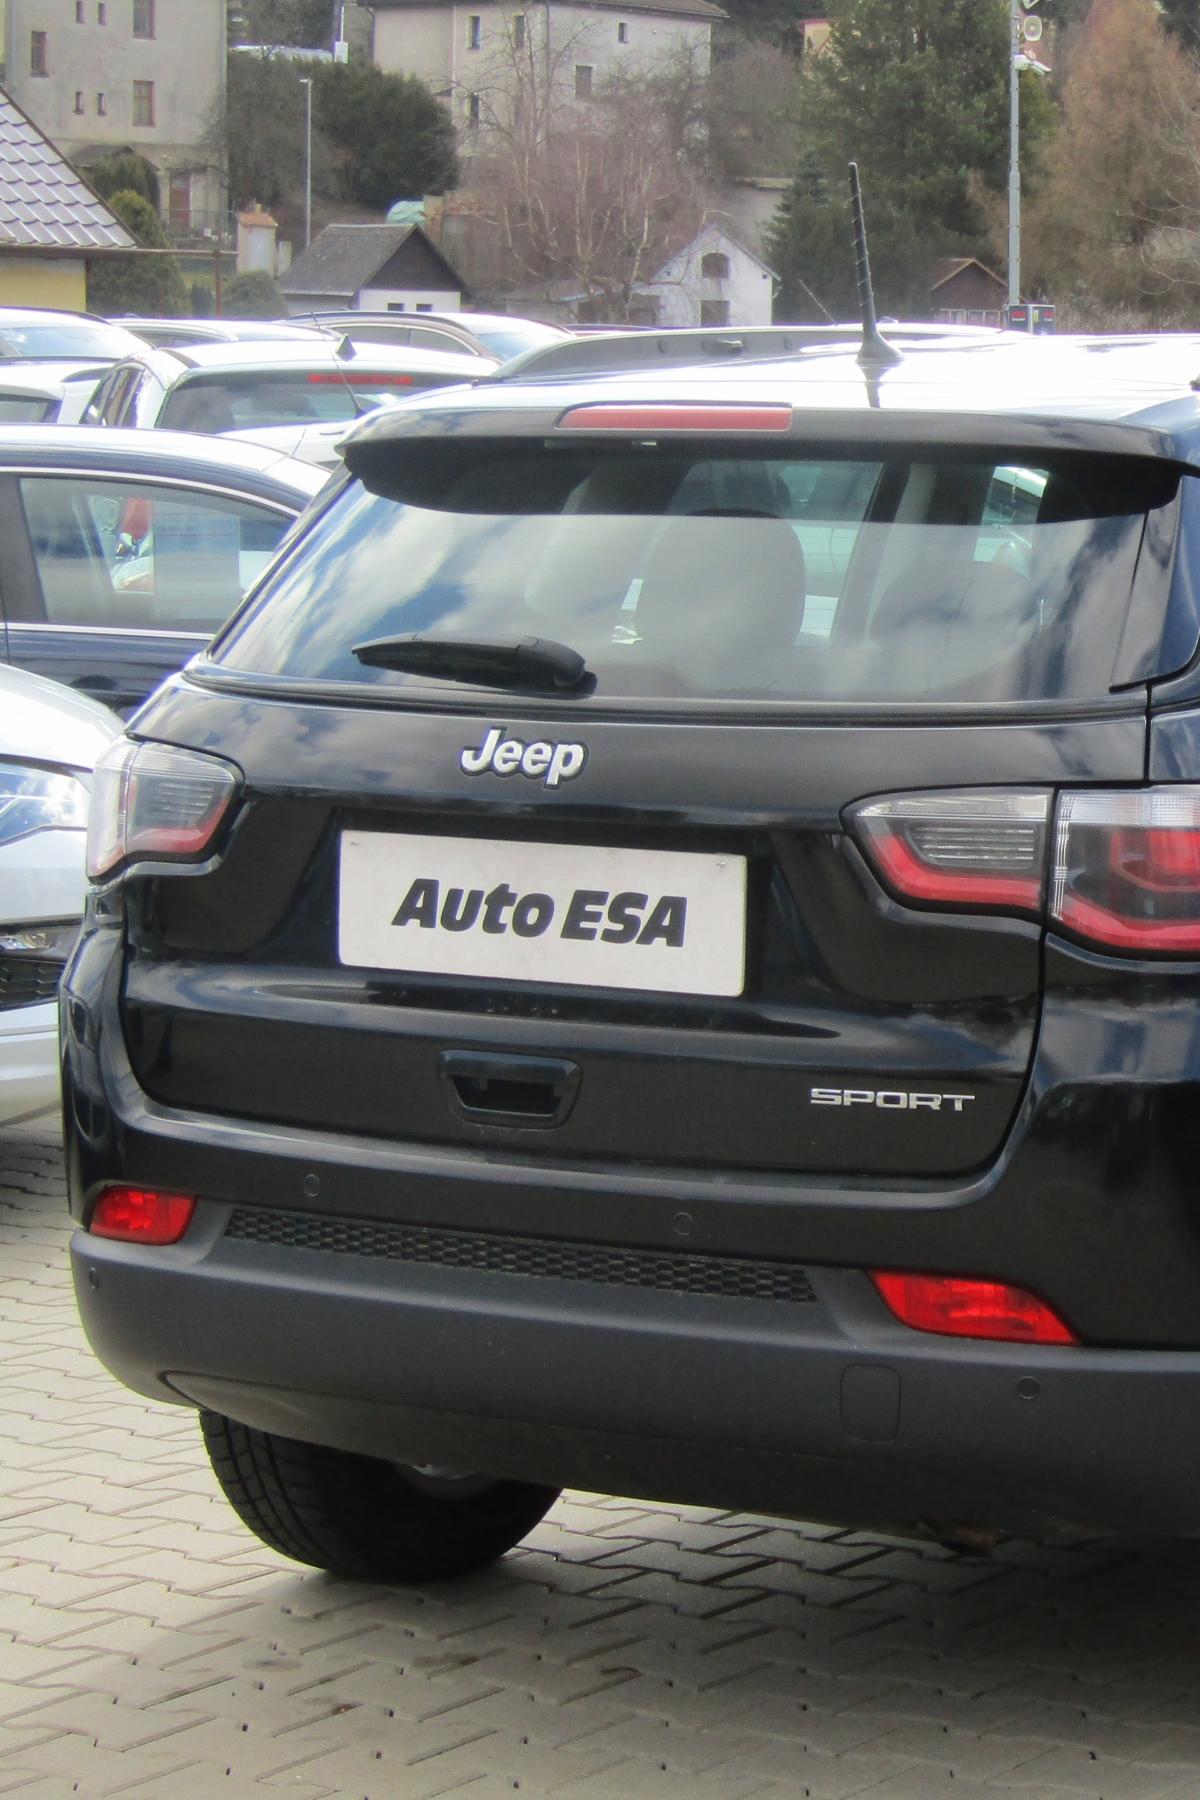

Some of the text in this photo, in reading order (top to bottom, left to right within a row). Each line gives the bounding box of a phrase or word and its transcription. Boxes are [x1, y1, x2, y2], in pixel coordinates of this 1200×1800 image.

[461, 729, 585, 785] Jeep
[391, 878, 687, 947] Auto ESA
[810, 1088, 976, 1111] SPORT
